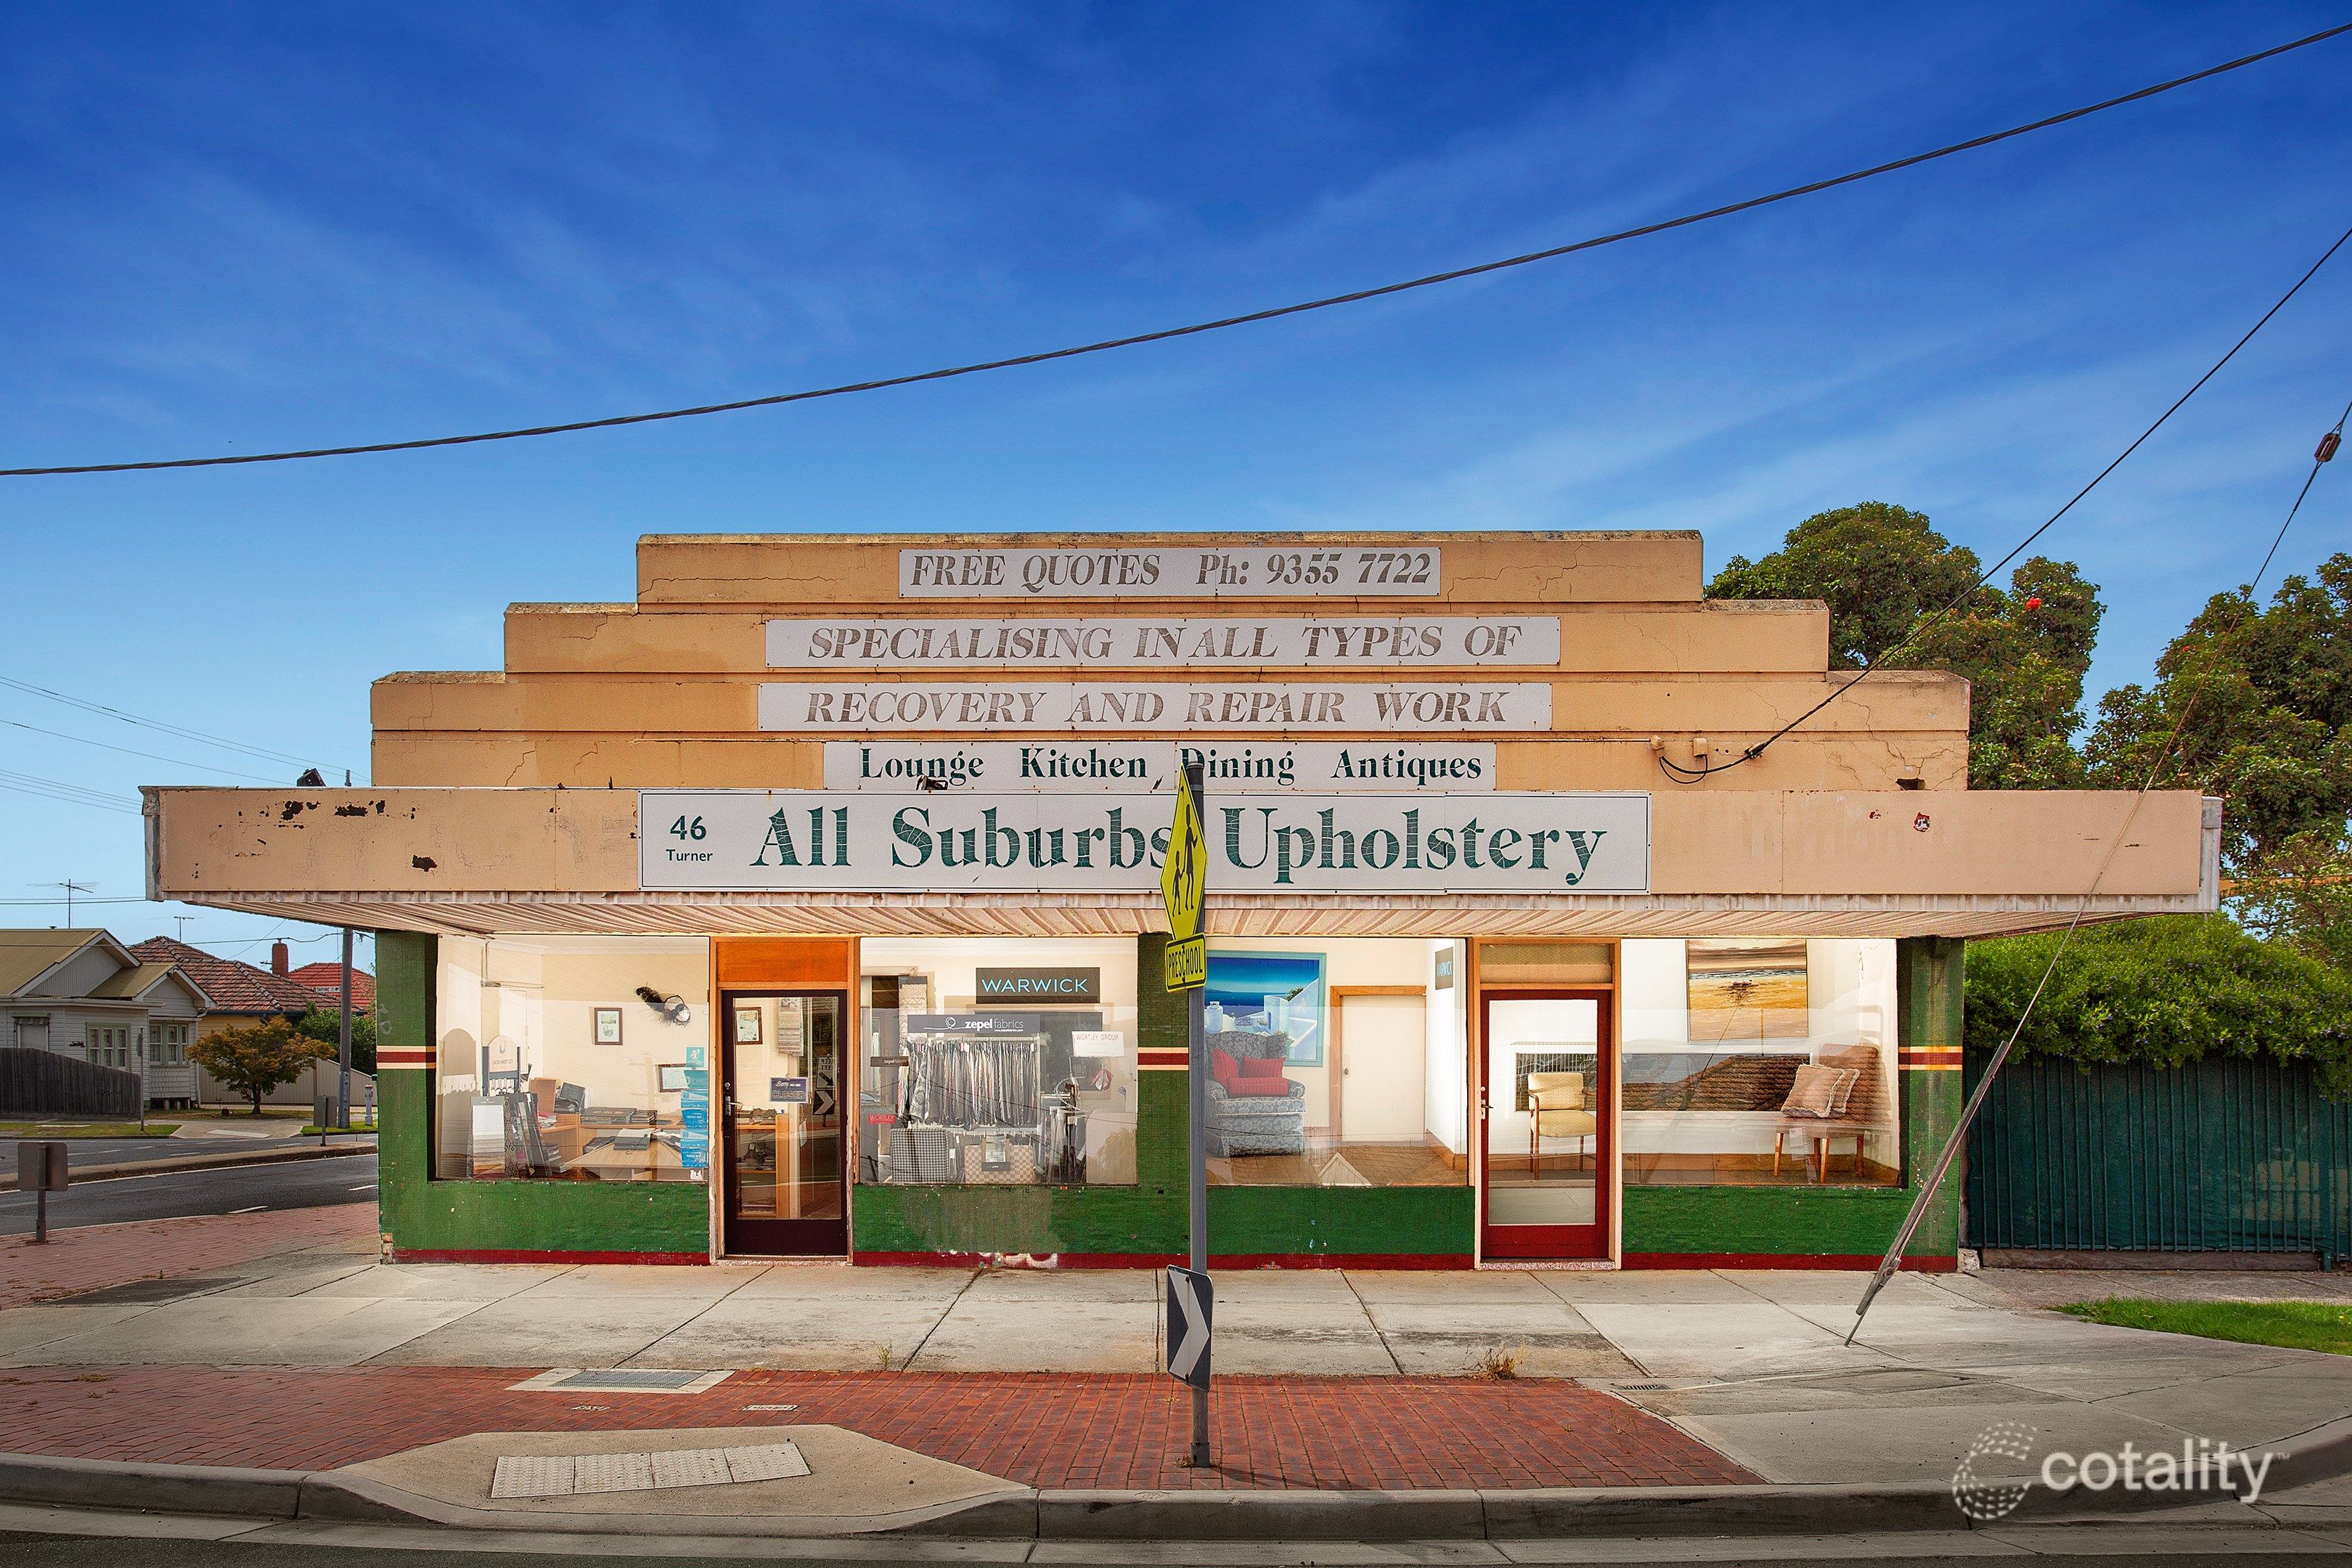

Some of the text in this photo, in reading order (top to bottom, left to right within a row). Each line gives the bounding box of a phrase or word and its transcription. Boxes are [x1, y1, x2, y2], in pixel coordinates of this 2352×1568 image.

[910, 552, 1431, 594] FREE QUOTES Ph: 9355 7722
[808, 627, 1114, 659] SPECIALISING
[1301, 626, 1442, 658] TYPES
[1464, 625, 1522, 657] OF
[804, 691, 1510, 723] RECOVERY AND REPAIR WORK
[859, 747, 1482, 787] Lounge Kitchen Dining Antiques
[669, 814, 707, 841] 46
[666, 849, 714, 862] Turner
[748, 805, 1608, 886] All Suburbs Upholstery
[1168, 944, 1204, 979] PRESCHOOL
[981, 978, 1089, 993] WARWICK
[964, 1018, 1024, 1032] zepel fabrics
[772, 1090, 806, 1099] CLOSED
